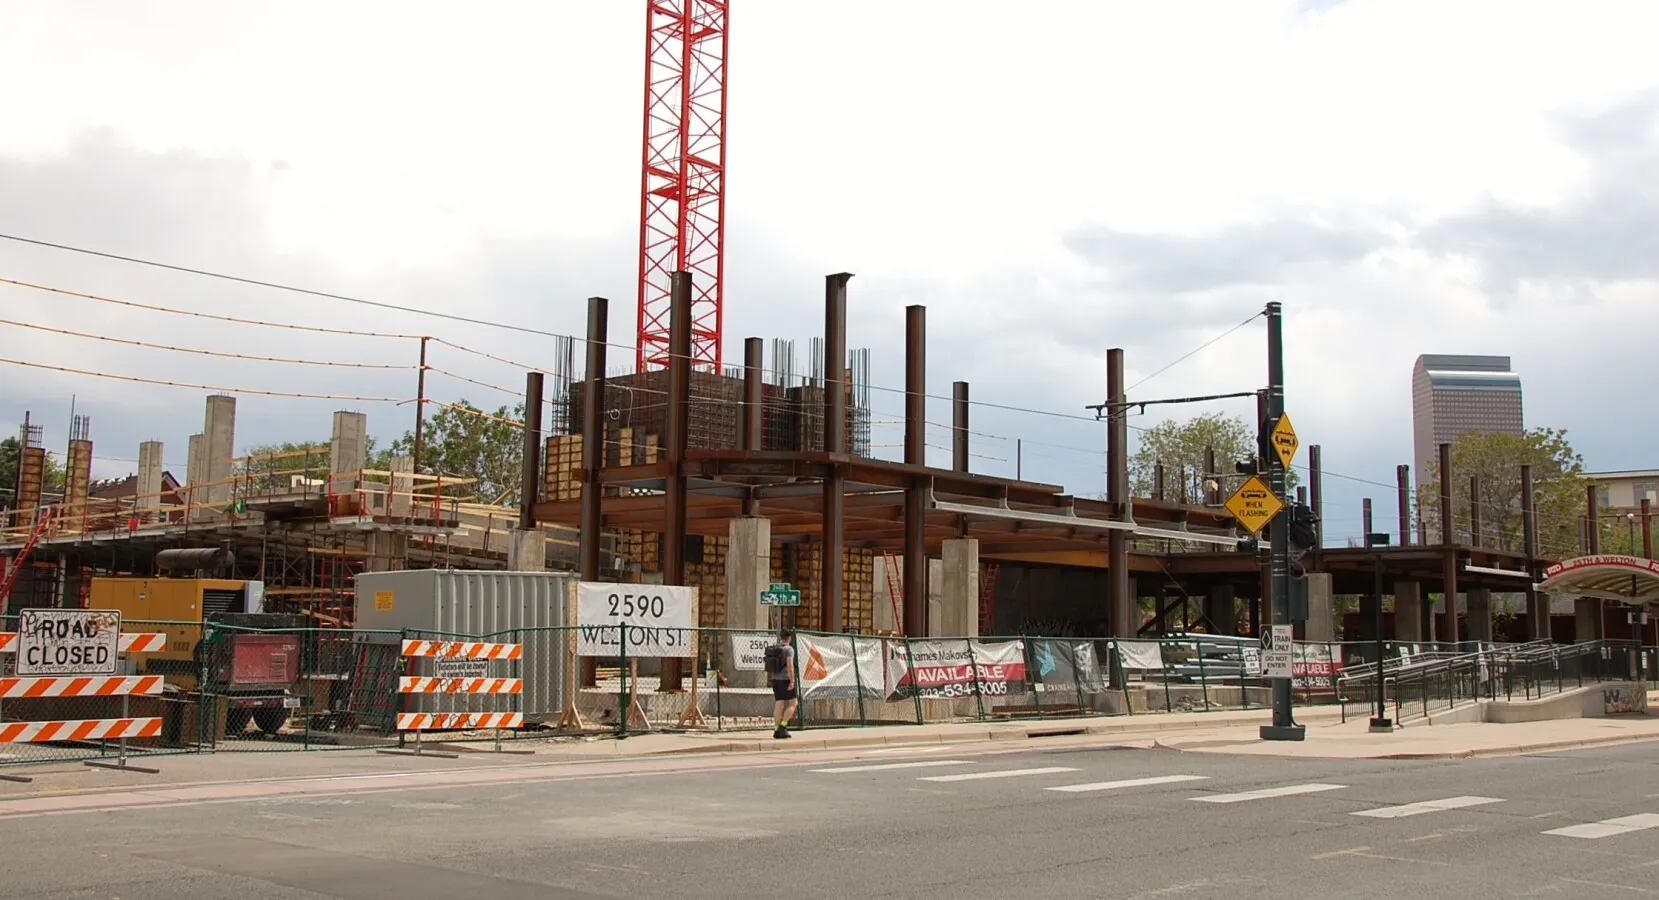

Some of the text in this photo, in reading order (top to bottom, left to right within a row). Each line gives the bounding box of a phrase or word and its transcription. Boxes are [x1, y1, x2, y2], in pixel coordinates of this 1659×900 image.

[1602, 555, 1637, 566] WELTON
[608, 593, 664, 618] 2590
[41, 619, 98, 638] ROAD
[581, 624, 660, 646] WELON
[749, 641, 769, 650] 2560
[1274, 635, 1291, 643] TRAIN
[27, 646, 109, 666] CLOSED
[1274, 644, 1289, 652] ONLY
[741, 654, 766, 664] Welto
[917, 664, 1005, 683] AVAILABLE
[919, 681, 1008, 698] 303-534-5005
